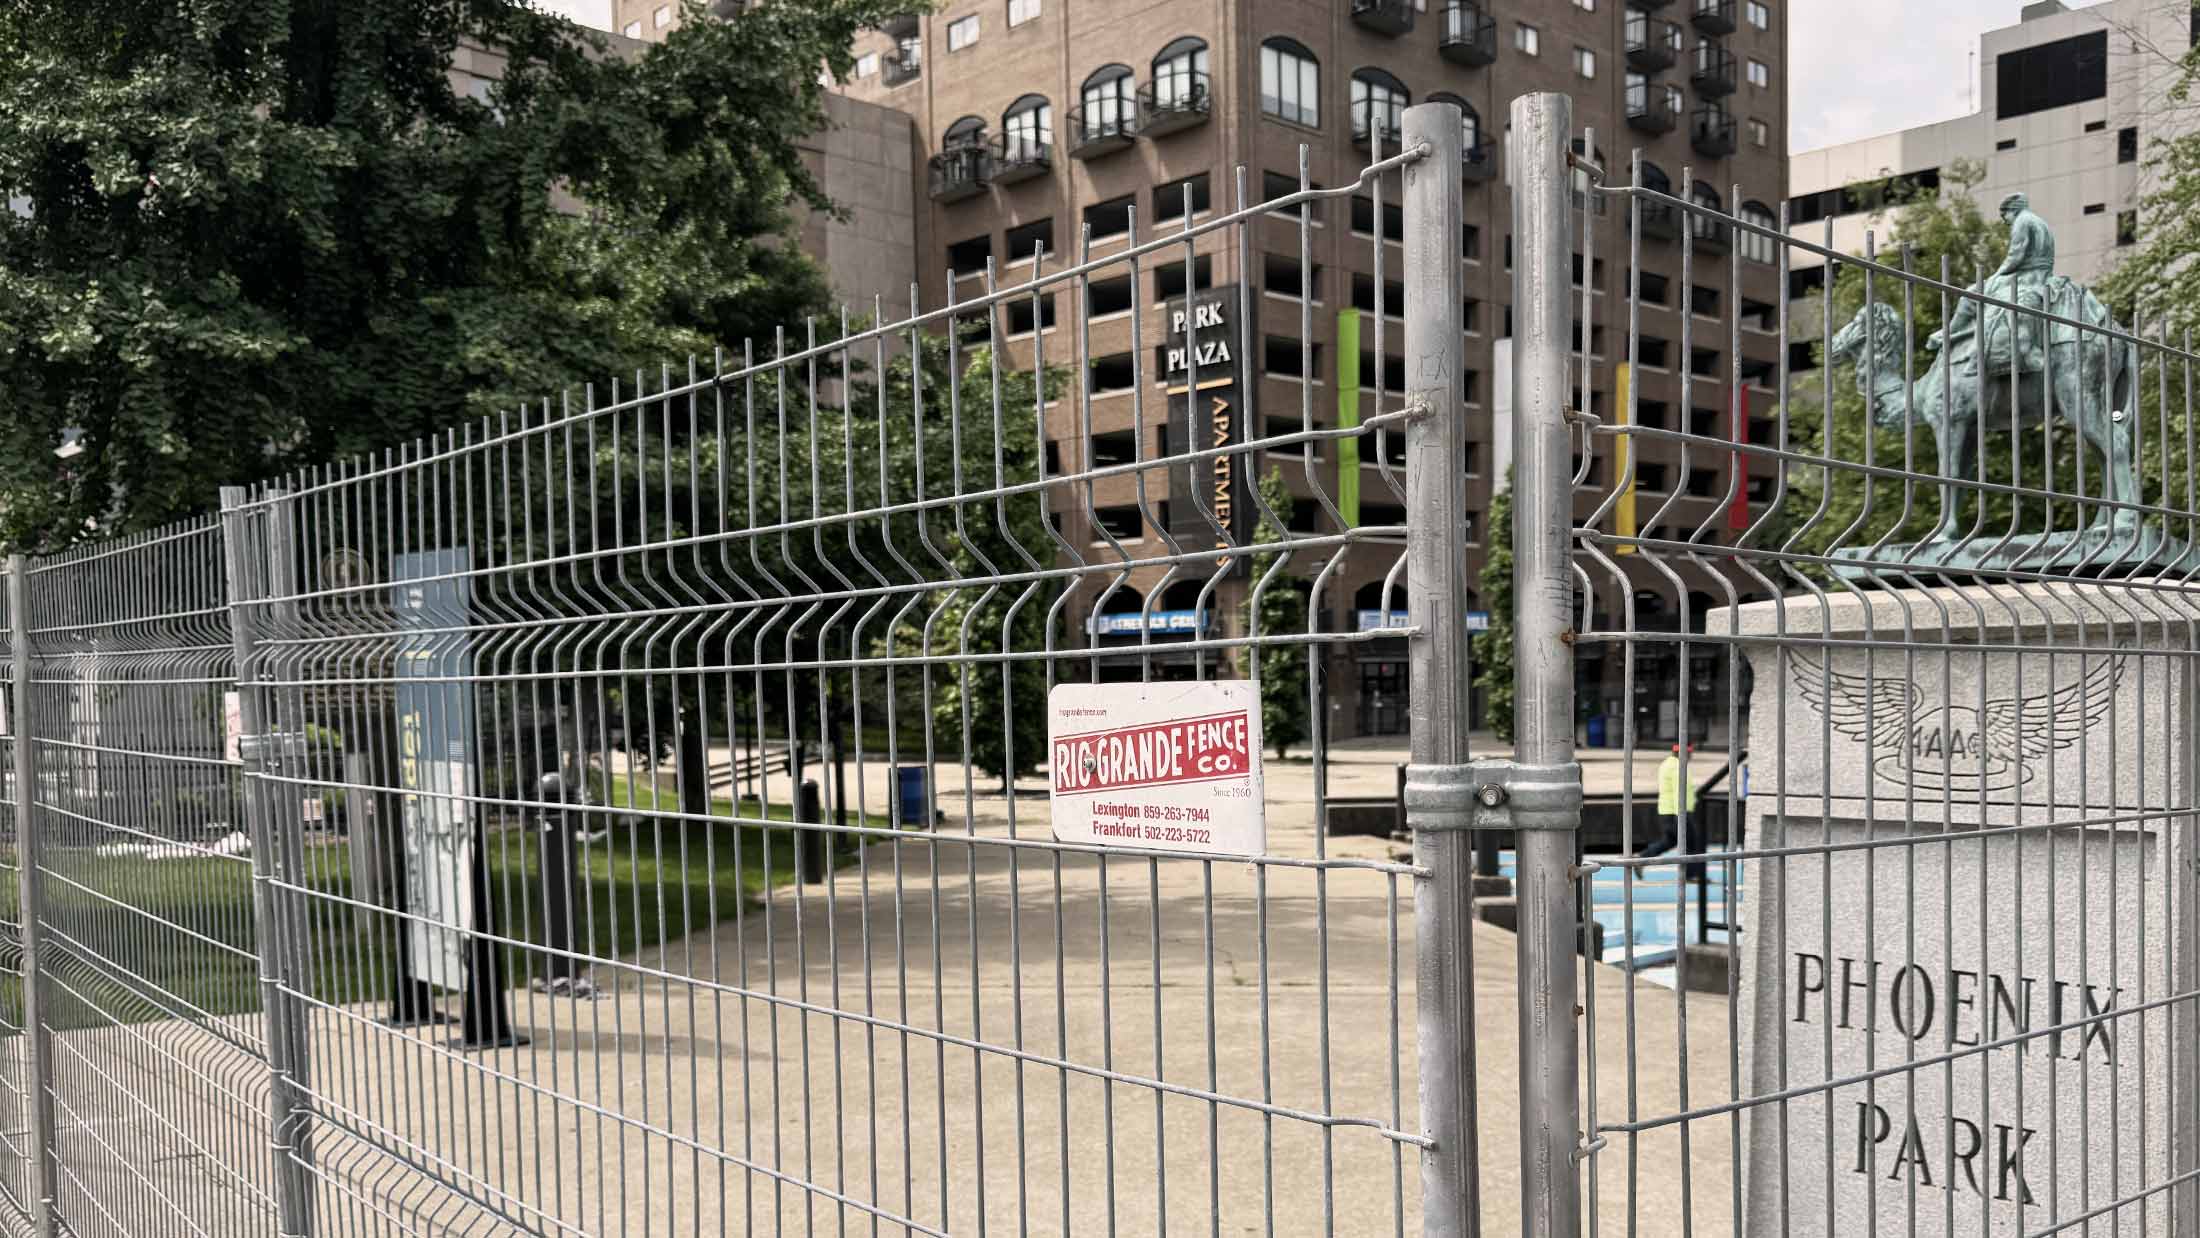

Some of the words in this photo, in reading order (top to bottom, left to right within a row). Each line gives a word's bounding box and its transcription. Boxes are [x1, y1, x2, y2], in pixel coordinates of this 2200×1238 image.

[1056, 740, 1093, 788] RIO
[1096, 727, 1183, 785] GRANDE
[1187, 718, 1246, 760] FENCE
[1197, 754, 1238, 774] CO.
[1213, 785, 1231, 798] Since
[1232, 786, 1252, 799] 1960
[1092, 800, 1141, 820] Lexington
[1143, 804, 1210, 823] 859-263-7944
[1092, 820, 1142, 839] Frankfort
[1144, 825, 1211, 844] 502-223-5722
[1793, 952, 2124, 1067] PHOENIX
[1853, 1101, 2041, 1208] PARK
